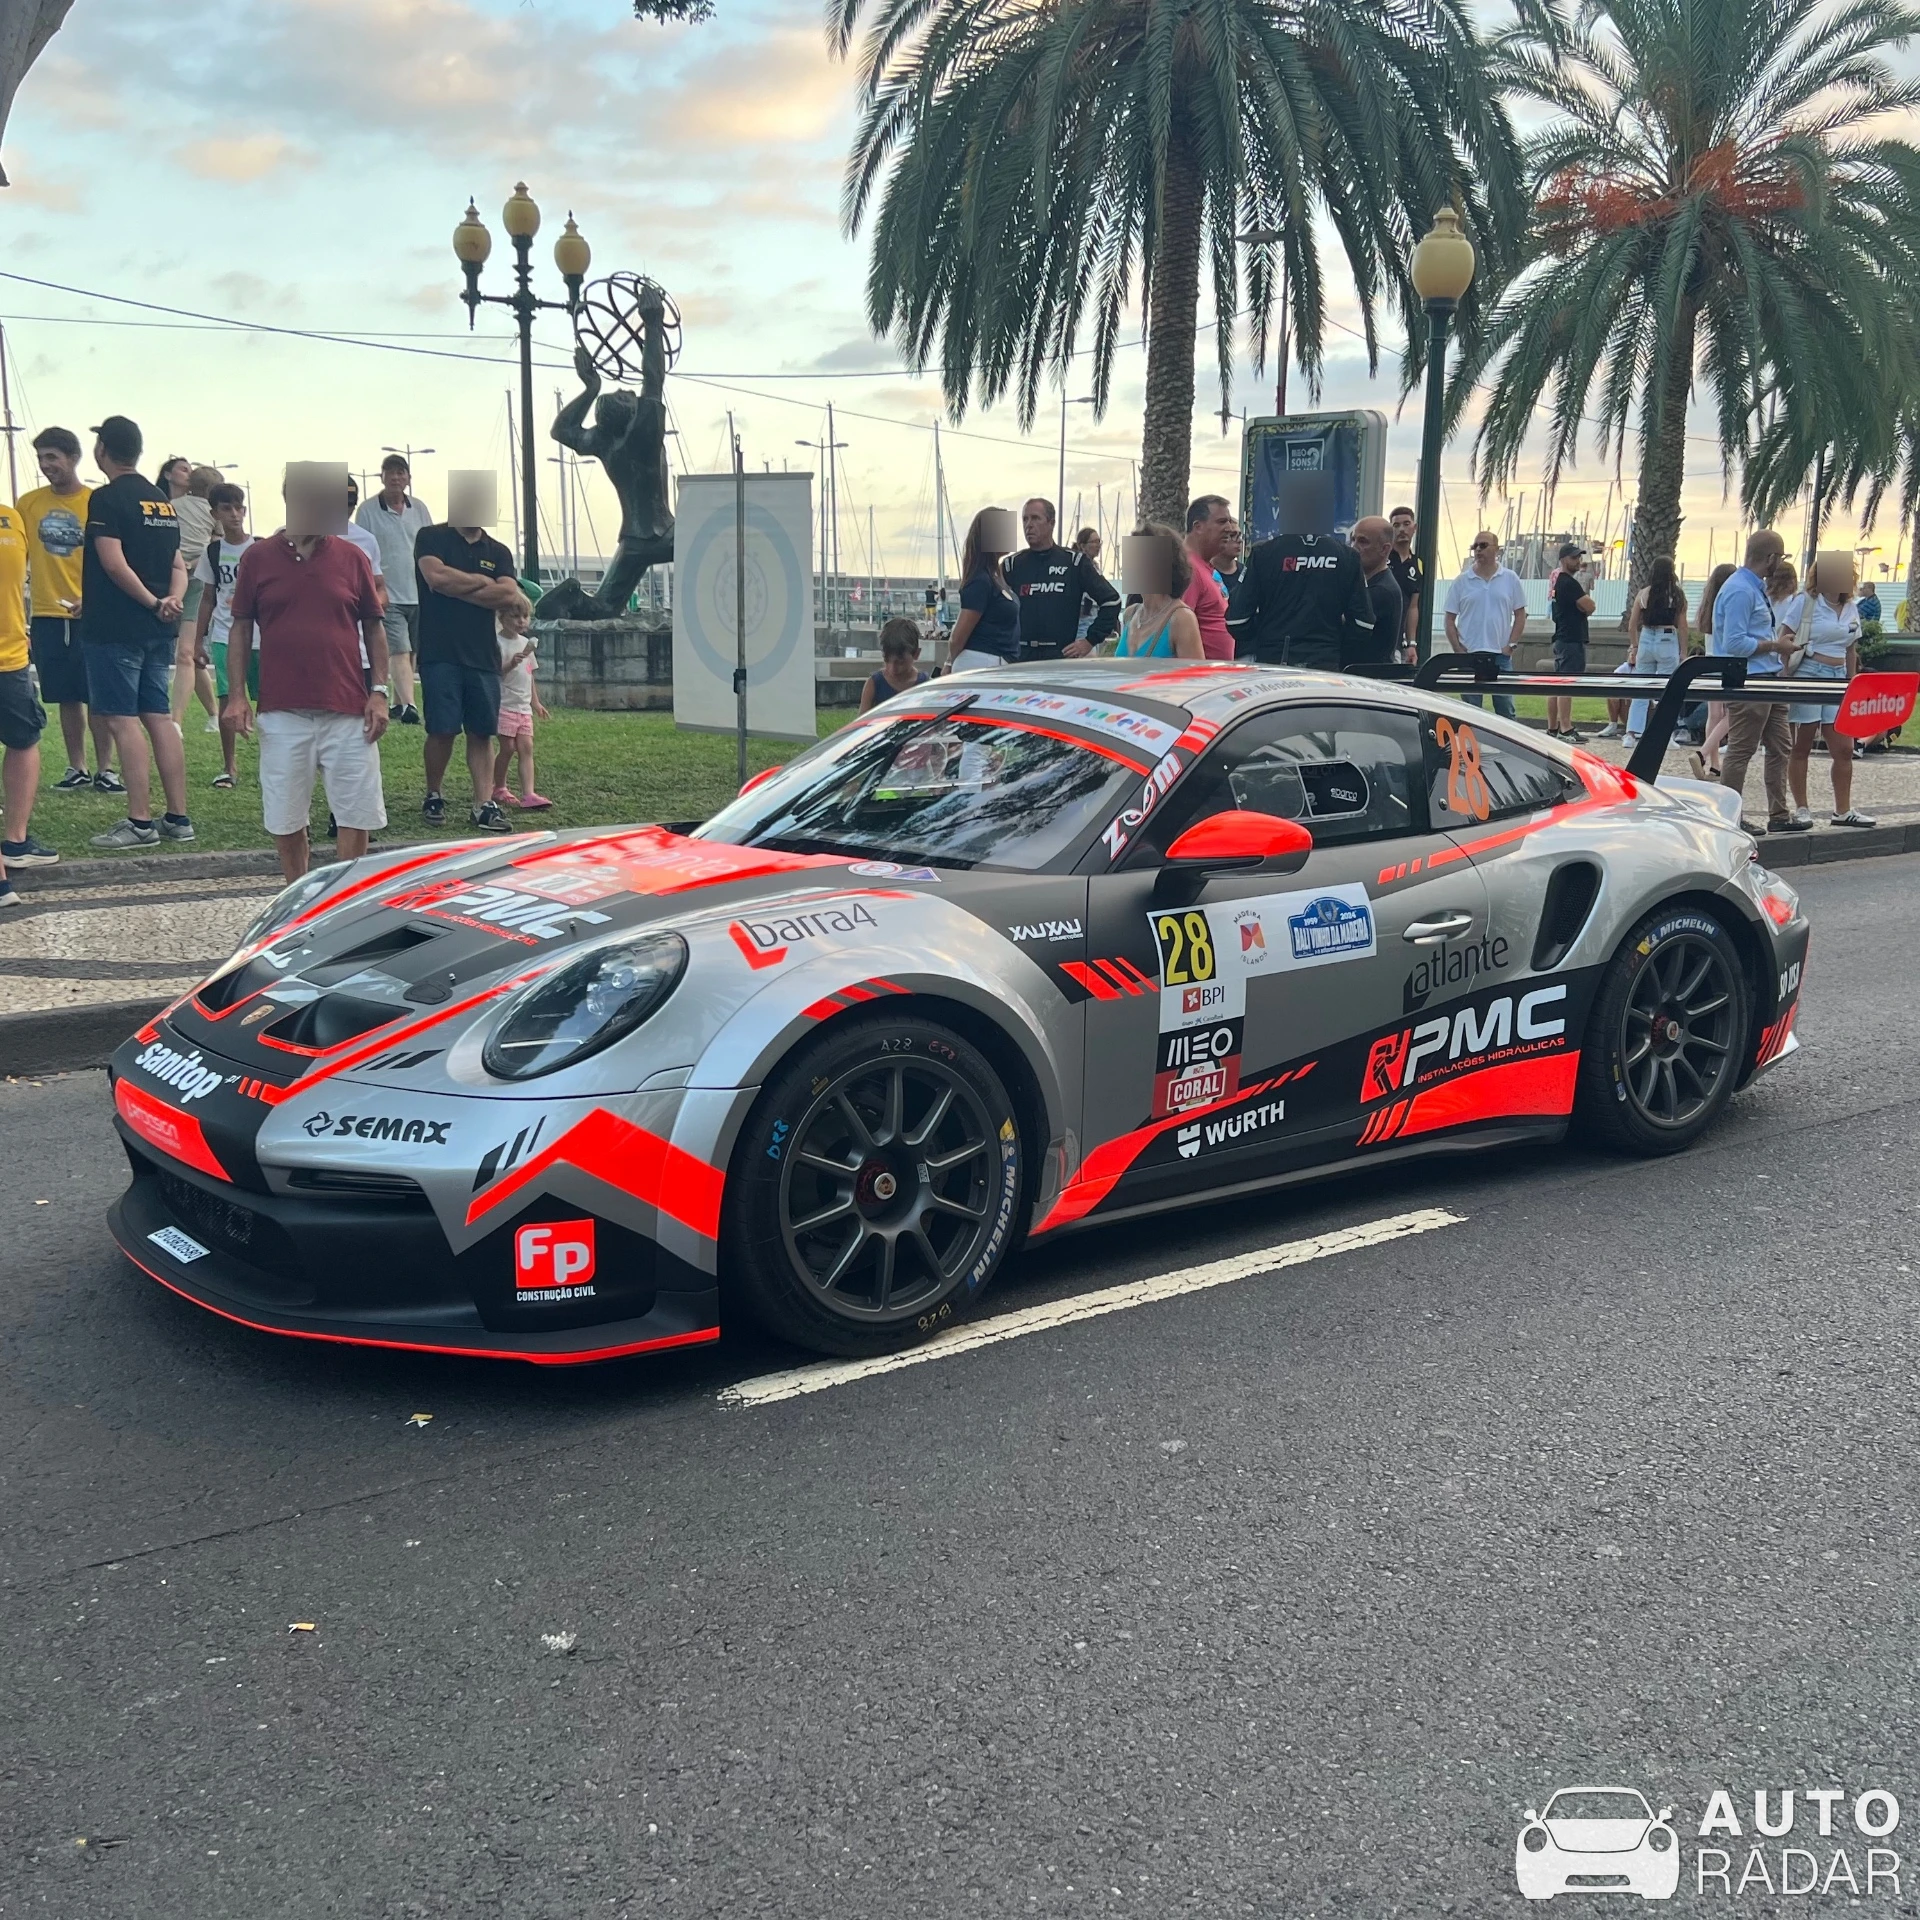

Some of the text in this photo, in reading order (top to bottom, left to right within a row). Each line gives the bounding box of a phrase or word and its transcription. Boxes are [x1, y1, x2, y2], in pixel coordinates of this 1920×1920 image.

[1291, 457, 1312, 467] SONS
[139, 501, 177, 517] FBI
[1048, 566, 1068, 575] PKF
[1295, 556, 1338, 572] PMC
[1029, 582, 1065, 596] PMC
[1258, 680, 1305, 694] Mendes
[1849, 692, 1906, 717] sanitop
[1076, 705, 1165, 741] madeira
[1436, 717, 1490, 821] 28
[1330, 787, 1358, 801] sparco
[411, 886, 613, 939] PMC
[1233, 910, 1261, 925] MADEIRA
[1340, 911, 1357, 921] 2024
[739, 903, 880, 948] barra4
[1340, 916, 1369, 944] MADEIRA
[1660, 918, 1715, 938] MICHELIN
[1158, 912, 1213, 985] 28
[1240, 950, 1268, 965] ISLANDS
[1413, 933, 1509, 993] atlante
[1201, 985, 1225, 1007] BPI
[881, 1037, 912, 1052] A28
[1166, 1027, 1233, 1068] MEO
[1403, 984, 1567, 1087] PMC
[1417, 1037, 1565, 1084] INSTALAÇÕES HIDRÁULICAS
[135, 1042, 223, 1104] sanitop
[1174, 1076, 1220, 1100] CORAL
[333, 1115, 452, 1145] SEMAX
[1205, 1100, 1285, 1146] WÜRTH
[973, 1164, 1016, 1283] MICHELIN
[516, 1285, 596, 1301] CONSTRUÇÃO CIVIL
